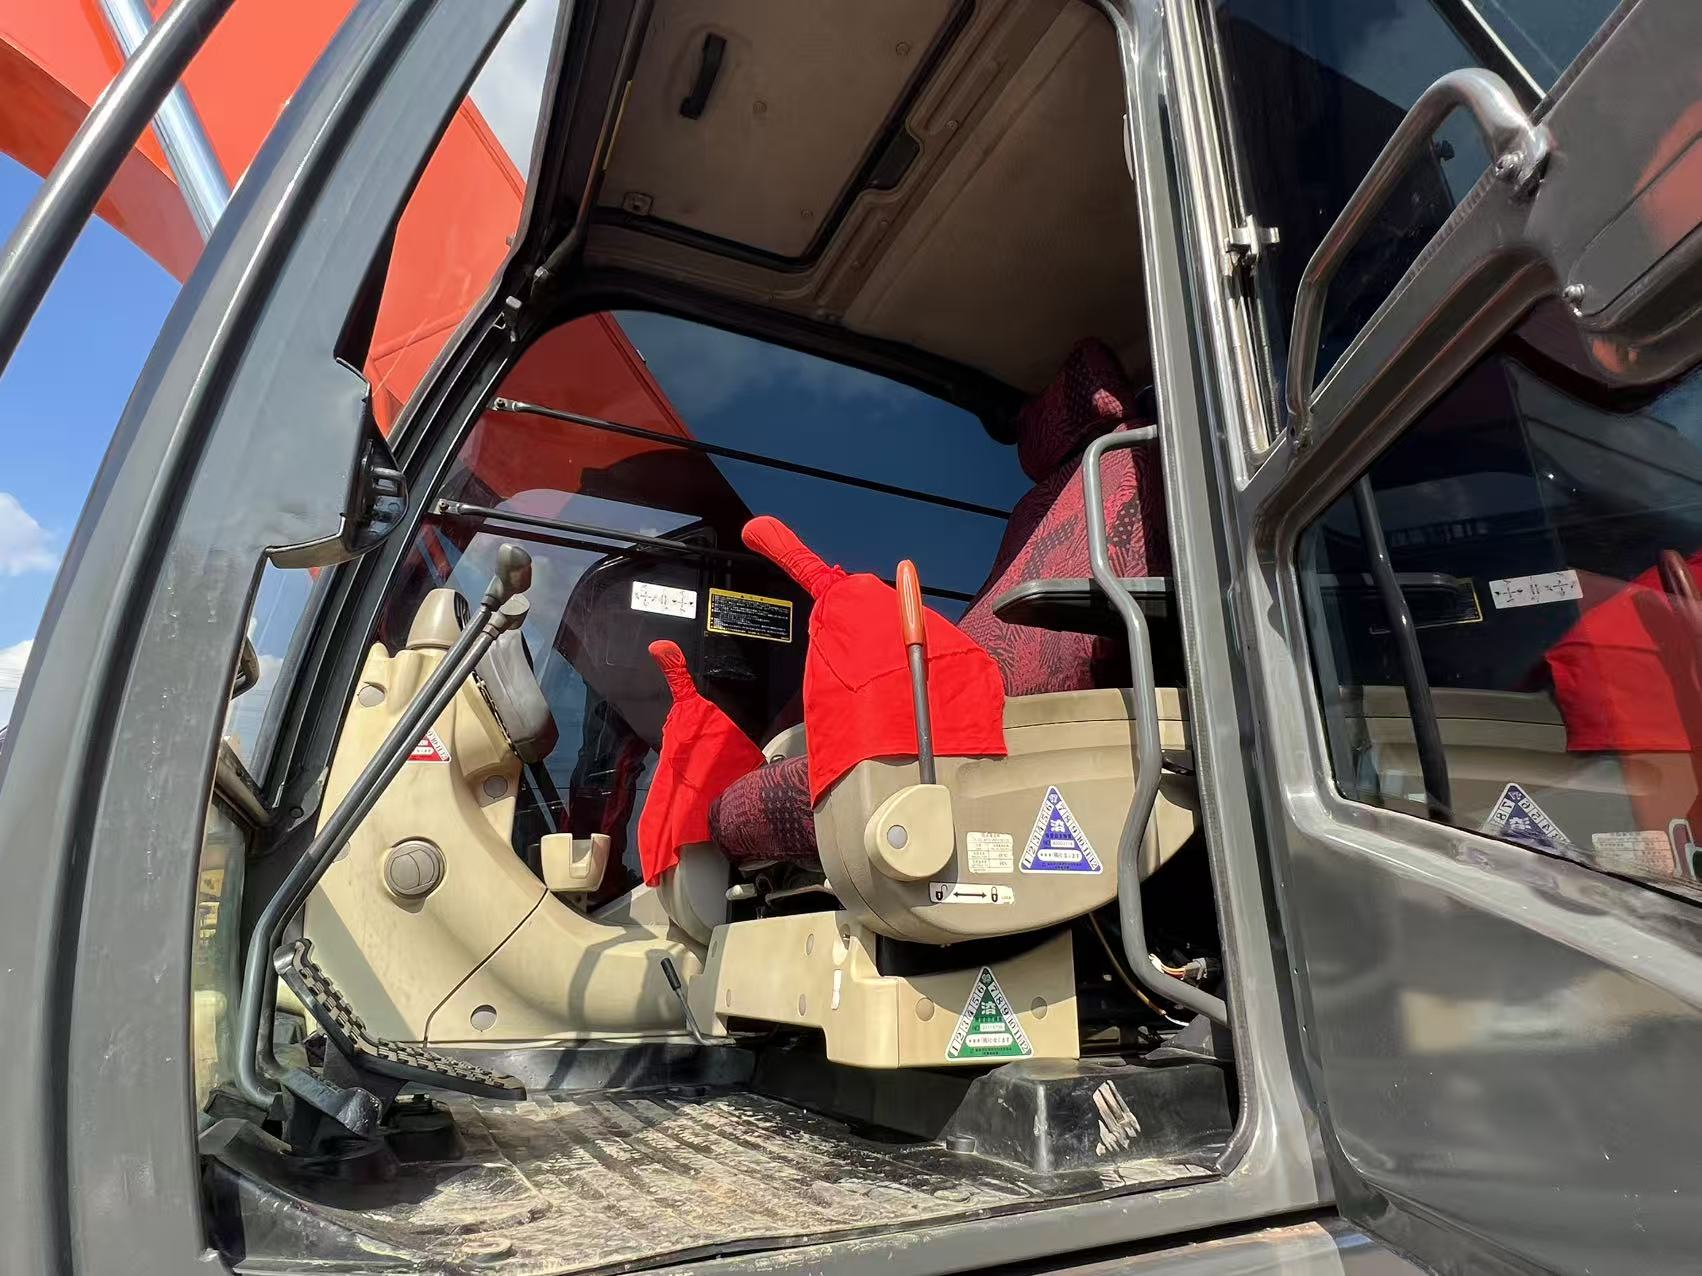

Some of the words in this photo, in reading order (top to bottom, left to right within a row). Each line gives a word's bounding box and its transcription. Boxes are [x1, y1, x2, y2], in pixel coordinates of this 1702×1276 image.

[1029, 846, 1036, 856] 2
[1033, 835, 1040, 844] 3
[1046, 803, 1052, 812] 6
[1077, 836, 1085, 846] 10
[1083, 847, 1091, 857] 11
[1090, 858, 1098, 869] 12
[962, 1020, 969, 1029] 3
[977, 985, 983, 993] 6
[981, 1001, 996, 1015] 済
[996, 995, 1004, 1004] 8
[1002, 1007, 1009, 1016] 9
[1007, 1018, 1016, 1028] 10
[1013, 1031, 1022, 1040] 11
[1020, 1040, 1030, 1052] 12
